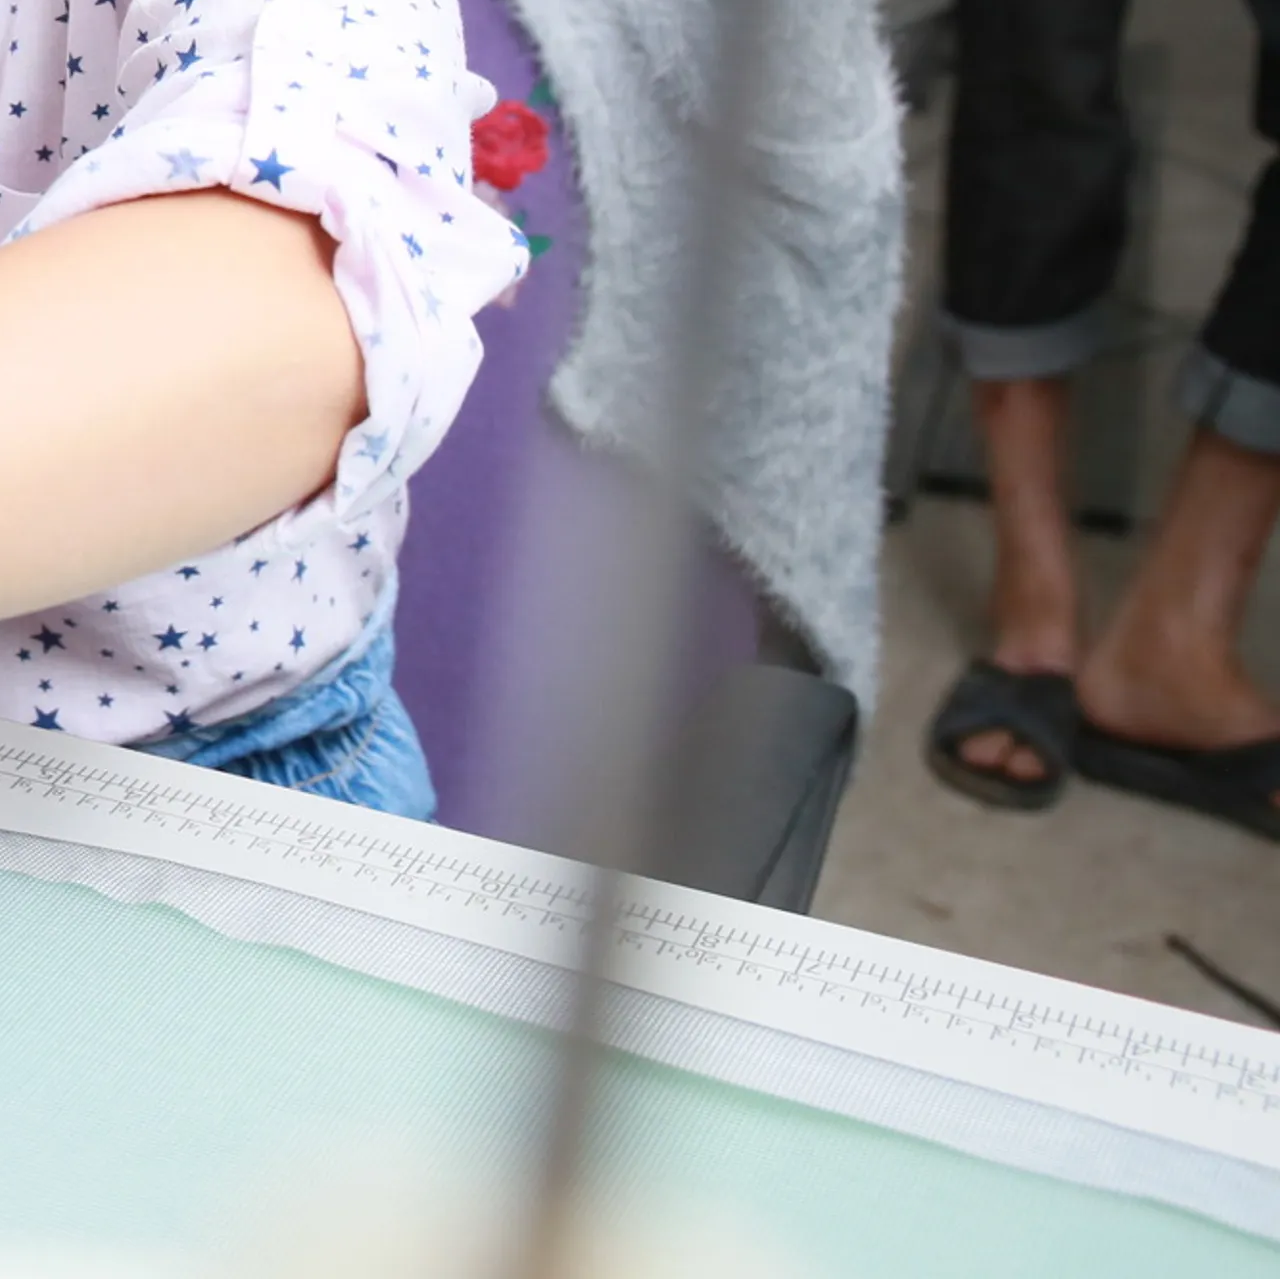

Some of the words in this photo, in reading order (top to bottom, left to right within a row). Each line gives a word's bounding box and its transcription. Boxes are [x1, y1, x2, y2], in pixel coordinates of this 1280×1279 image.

[37, 768, 73, 785] 15
[124, 789, 158, 806] 14
[209, 811, 243, 827] 13
[297, 833, 333, 849] 12
[392, 858, 424, 873] 11
[481, 881, 519, 898] 10
[699, 934, 719, 948] 8
[805, 961, 822, 975] 7
